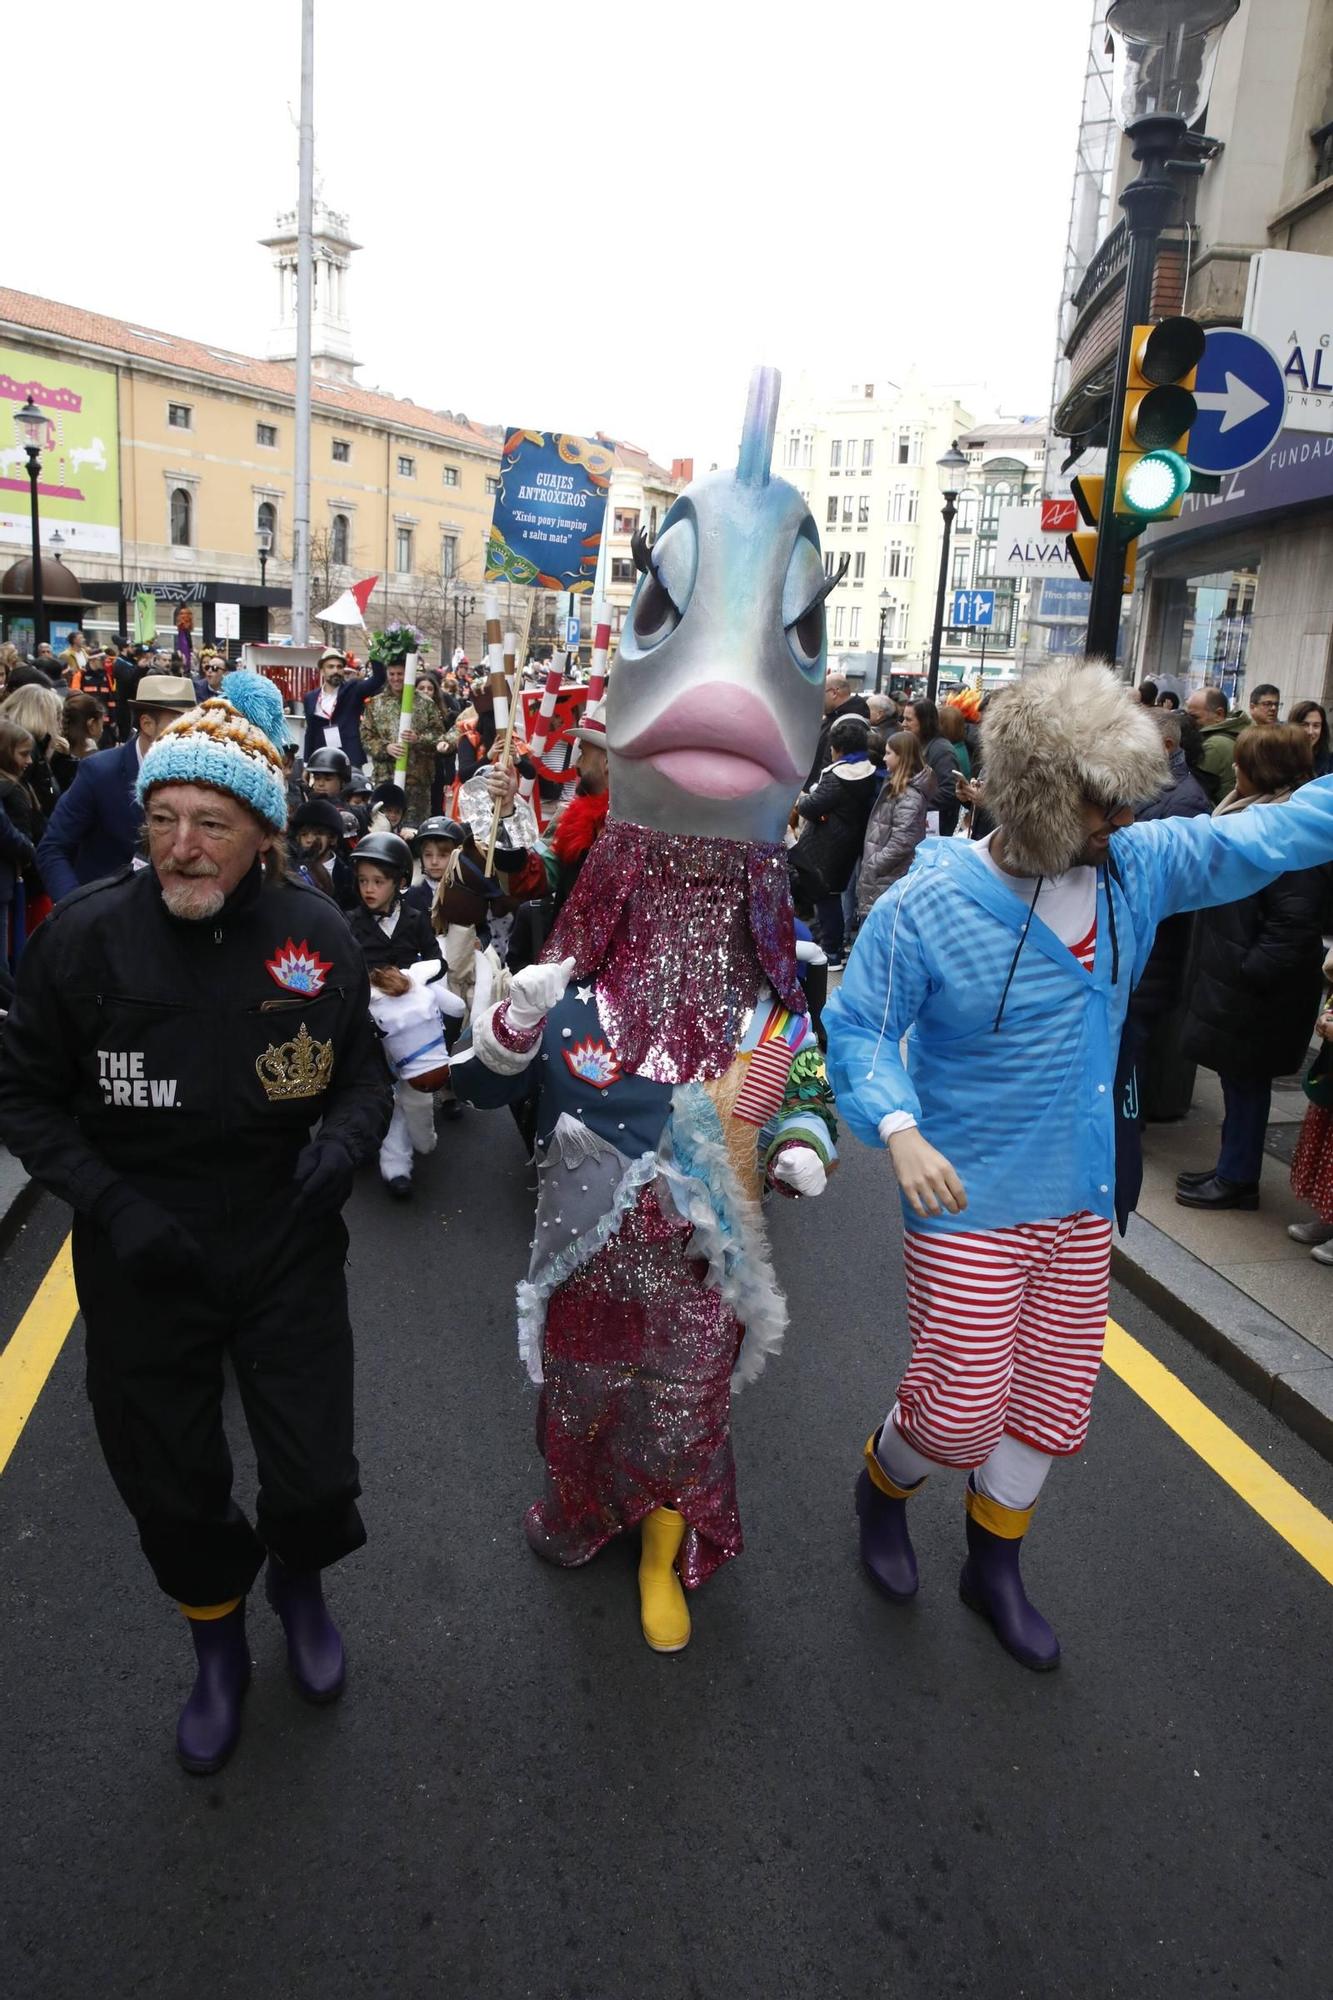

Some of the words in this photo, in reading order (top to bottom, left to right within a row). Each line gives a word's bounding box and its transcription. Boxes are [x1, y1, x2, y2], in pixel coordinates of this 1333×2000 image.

[536, 472, 574, 490] GUAJES
[518, 485, 587, 507] ANTROXEROS
[537, 516, 557, 528] pony
[557, 516, 587, 532] jumping
[522, 530, 528, 538] a
[529, 529, 547, 541] saltu
[569, 620, 578, 641] P
[97, 1050, 145, 1078] THE
[98, 1078, 182, 1108] CREW.
